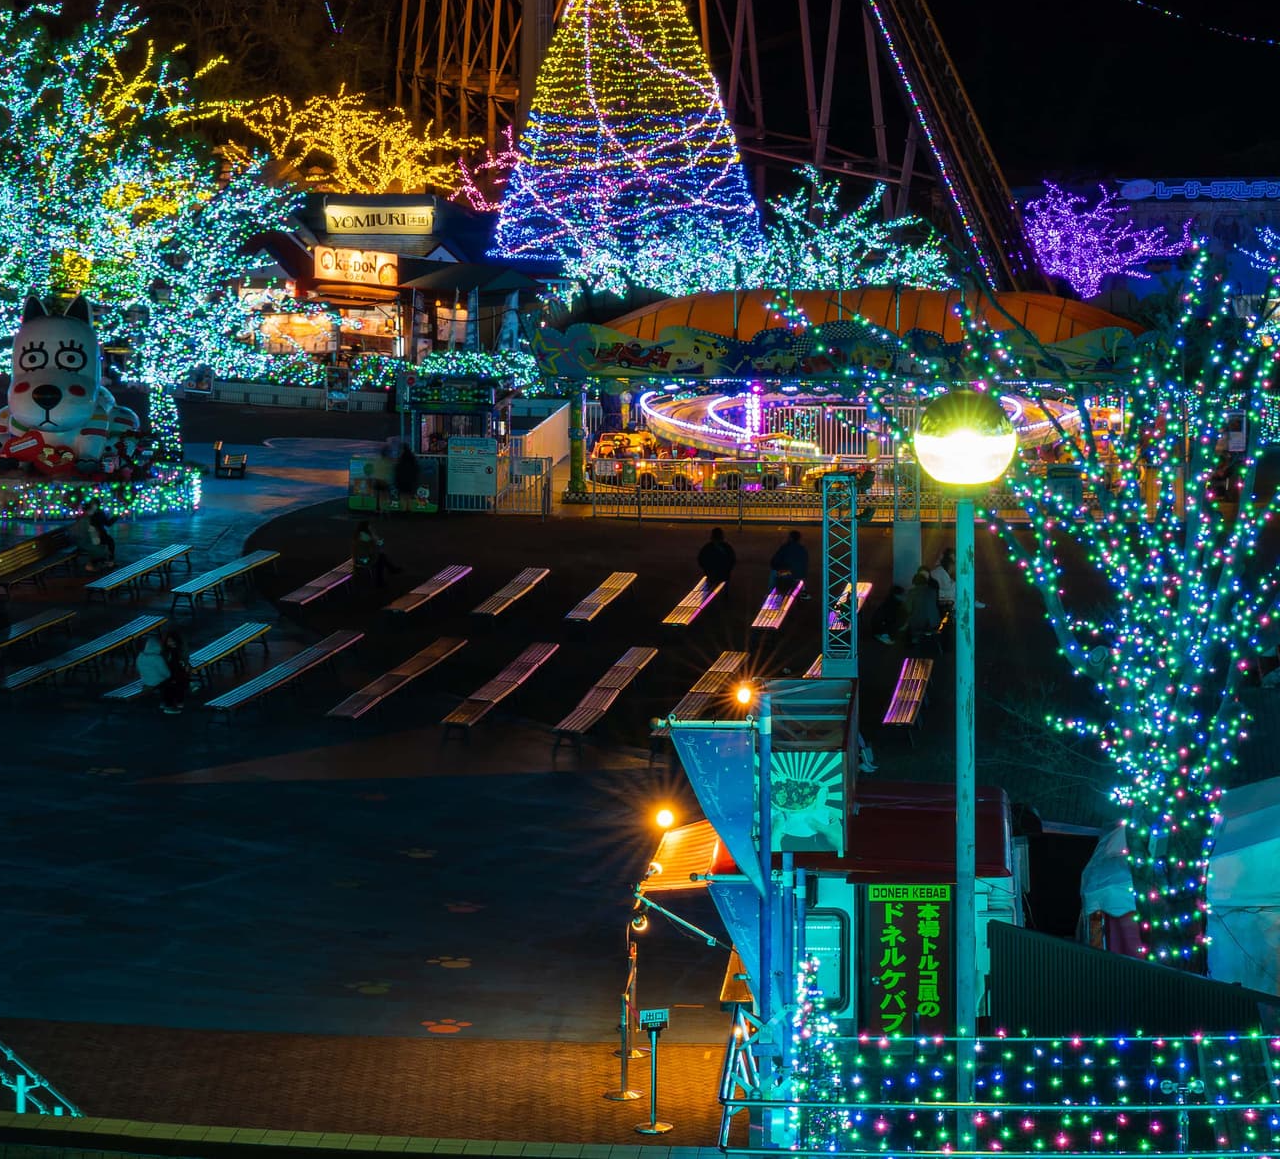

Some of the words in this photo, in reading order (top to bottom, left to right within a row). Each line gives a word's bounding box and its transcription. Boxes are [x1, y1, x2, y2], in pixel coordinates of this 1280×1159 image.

[331, 213, 406, 228] YOMIURI
[872, 887, 909, 899] DONER
[912, 887, 947, 899] KEBAB
[880, 903, 907, 1033] ドネルケバブ
[917, 903, 940, 1017] 本場トルコ風の
